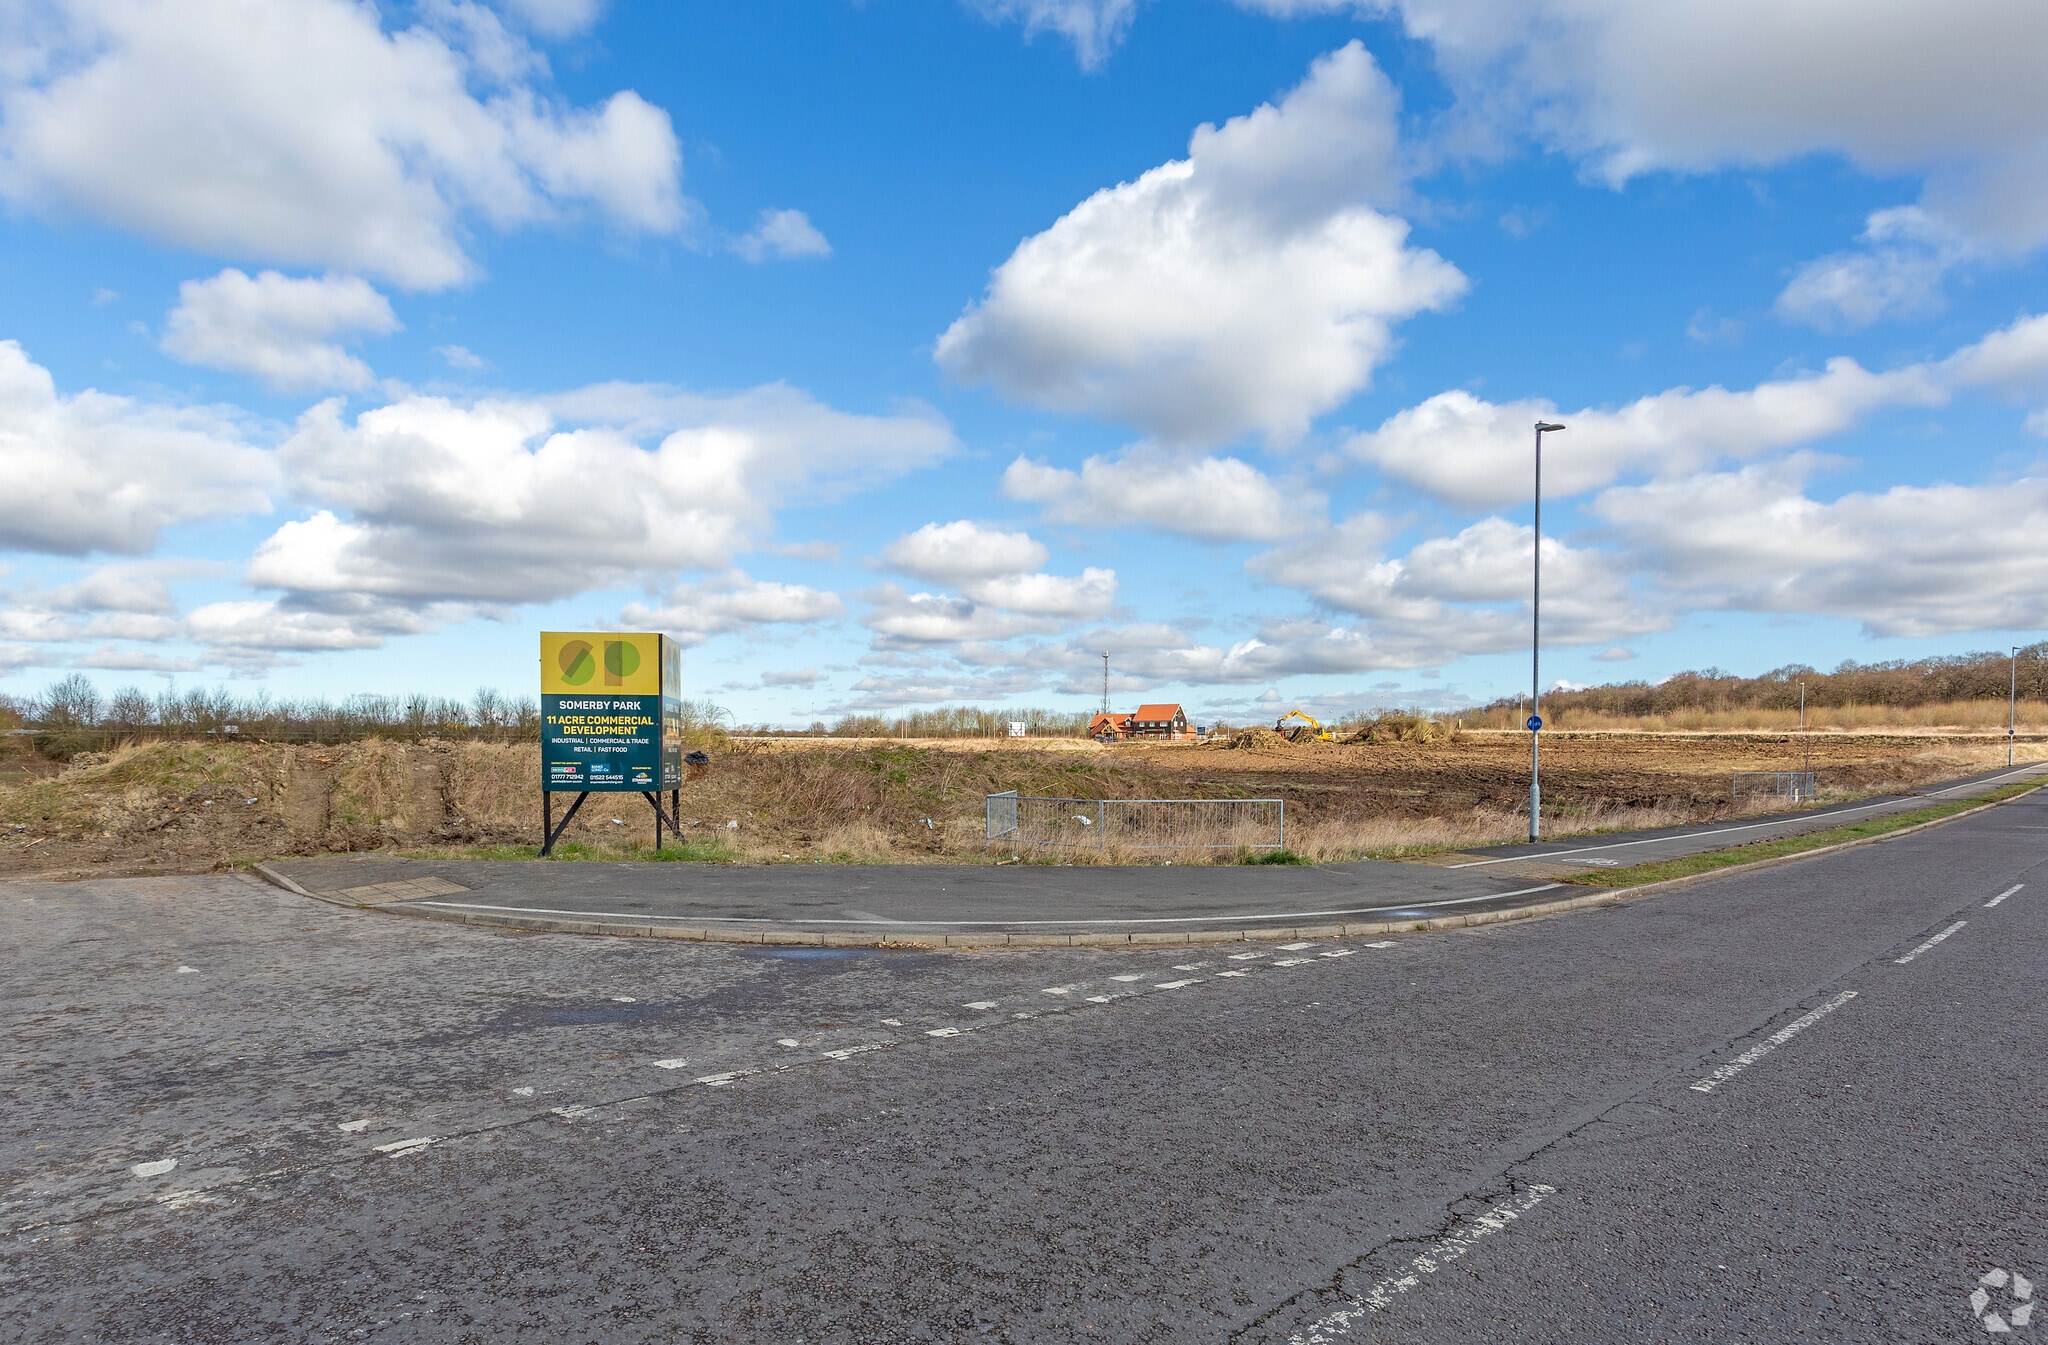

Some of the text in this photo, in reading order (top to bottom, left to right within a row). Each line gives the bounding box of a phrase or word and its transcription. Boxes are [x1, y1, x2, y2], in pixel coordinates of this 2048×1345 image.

[559, 701, 641, 710] SOMERBY PARK
[547, 716, 654, 725] 11 ACRE COMMERCIAL
[563, 726, 638, 735] DEVELOPMENT
